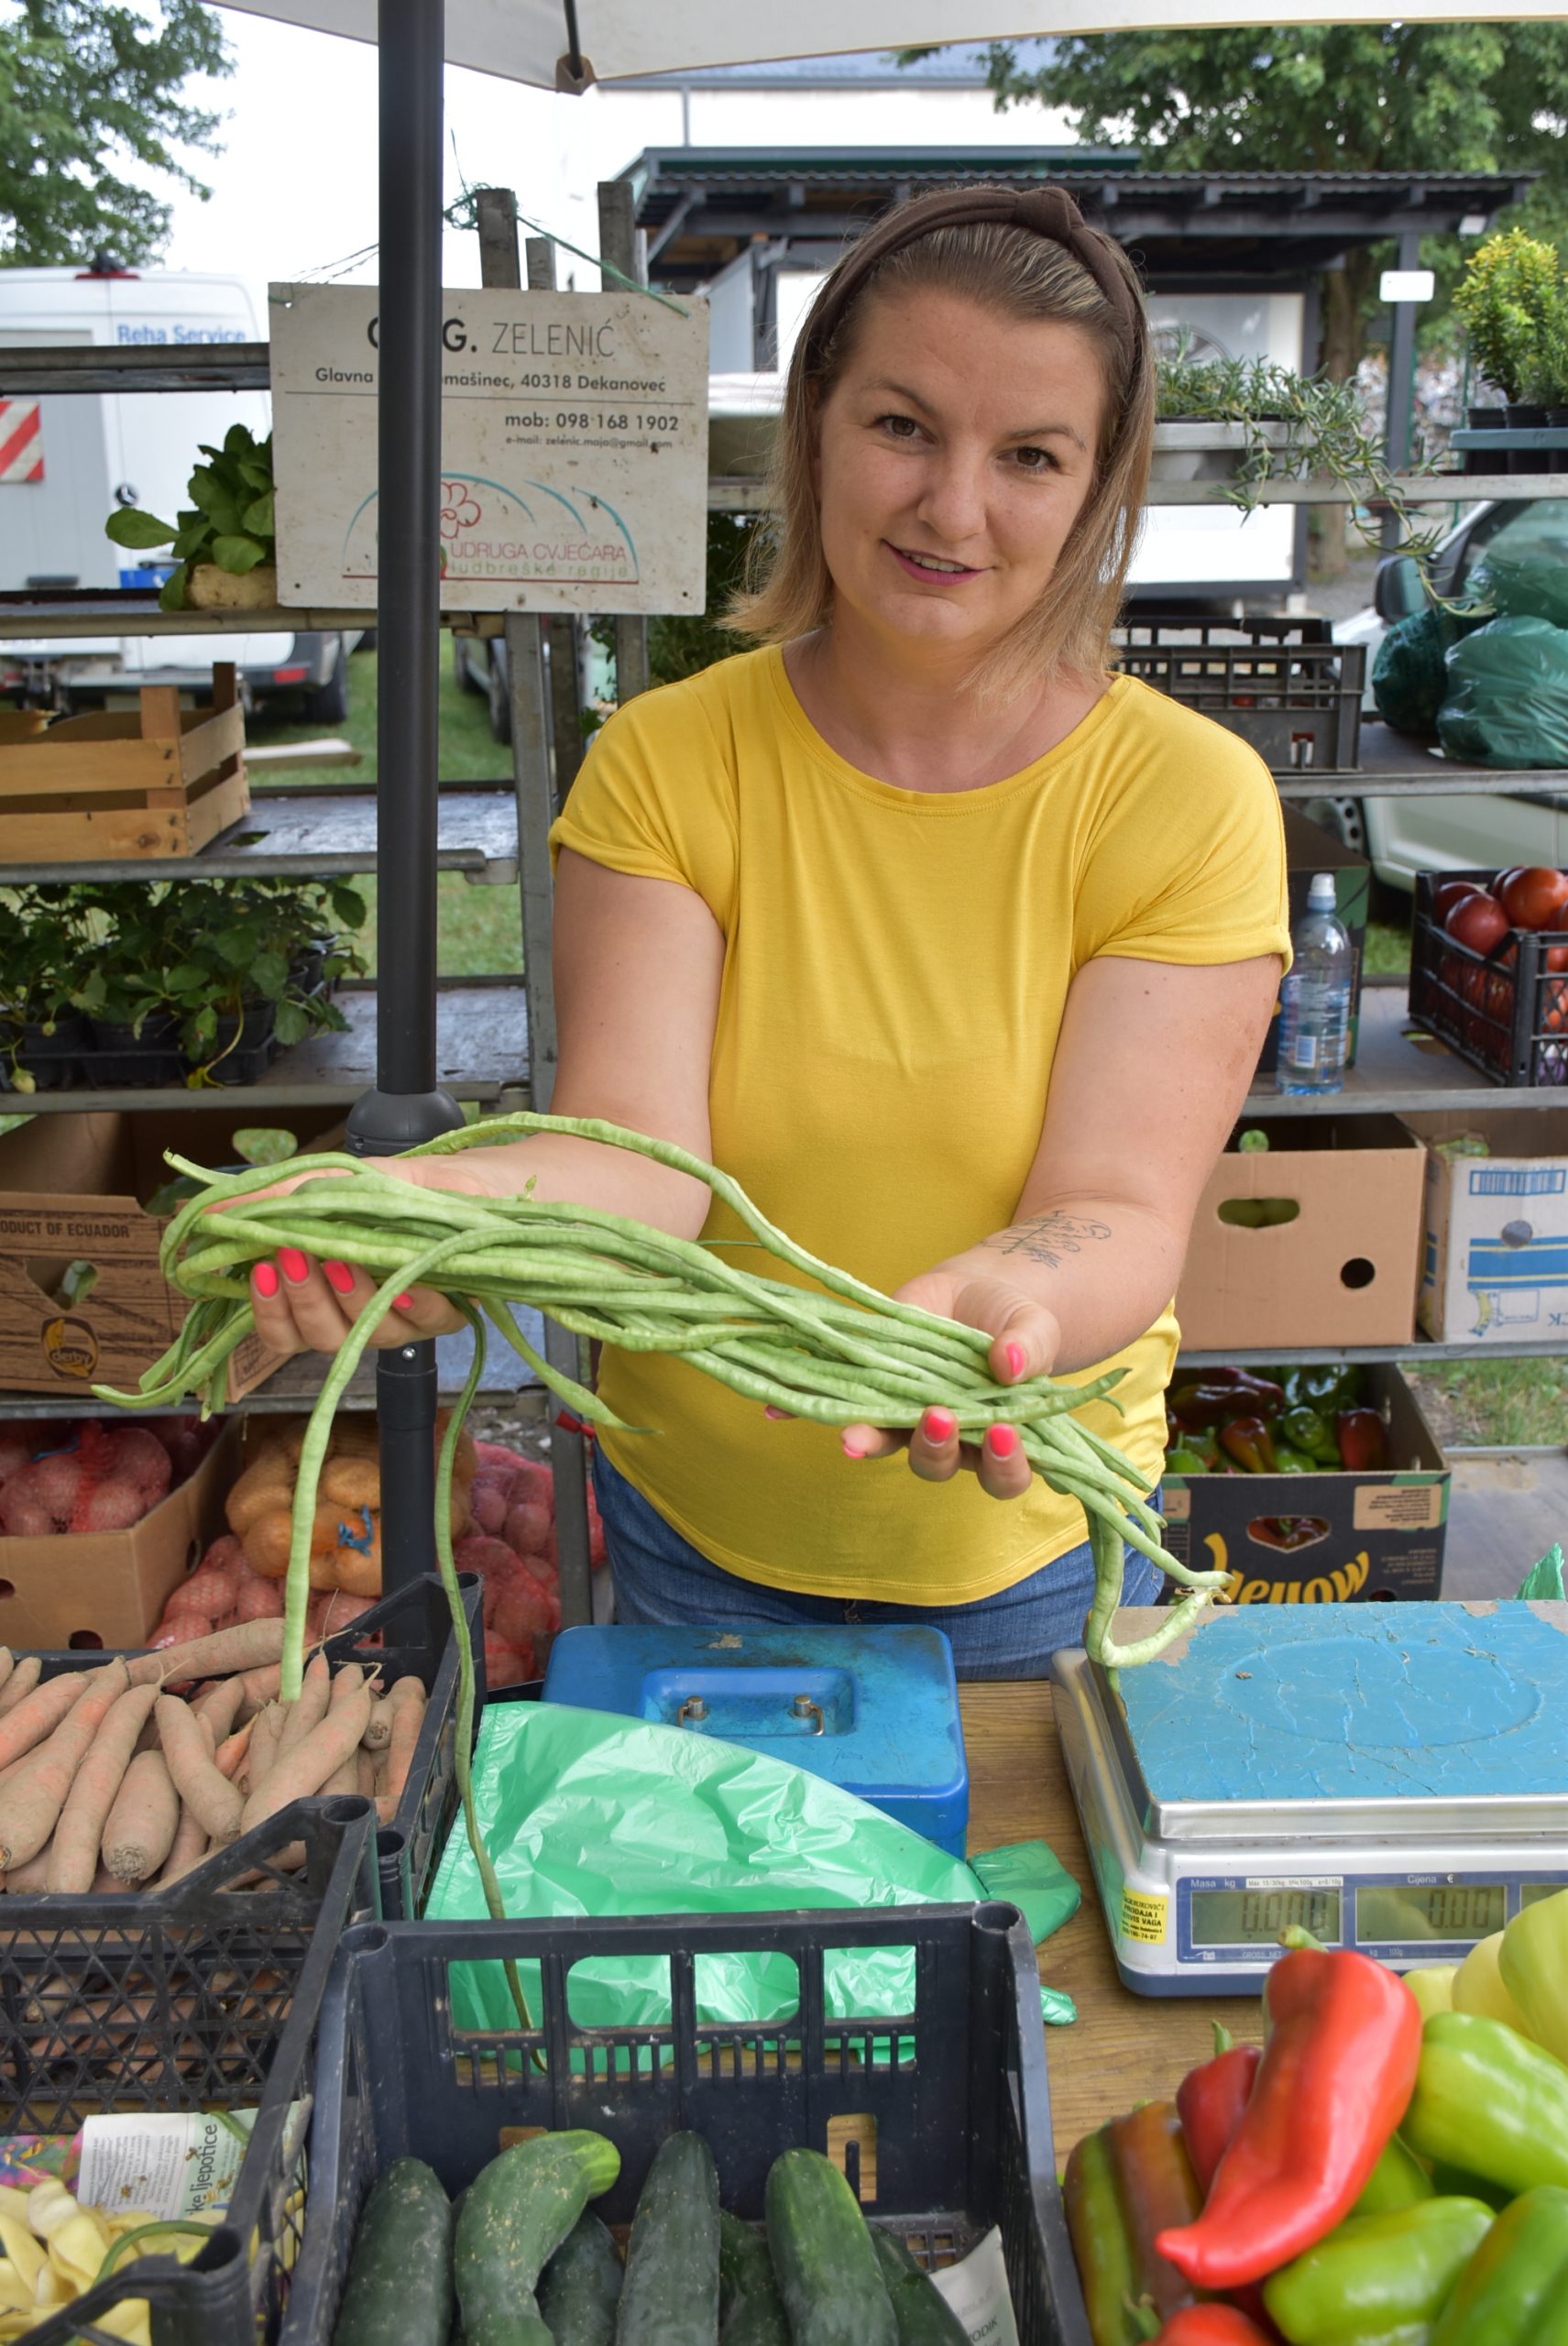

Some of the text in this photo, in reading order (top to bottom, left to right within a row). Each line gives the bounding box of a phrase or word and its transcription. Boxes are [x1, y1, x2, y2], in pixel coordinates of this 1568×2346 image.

[492, 318, 615, 357] ZELENIĆ
[315, 367, 374, 383] Glavna
[521, 374, 572, 389] 40318
[505, 411, 679, 431] mob: 098 168 1902
[506, 434, 543, 445] e-mail:
[450, 542, 528, 560] UDRUGA
[47, 1222, 62, 1235] OF
[67, 1223, 130, 1238] ECUADOR
[51, 1350, 92, 1368] derby
[1190, 1879, 1236, 1889] Masa kg
[1407, 1874, 1437, 1886] Cijena
[185, 2194, 206, 2215] ke
